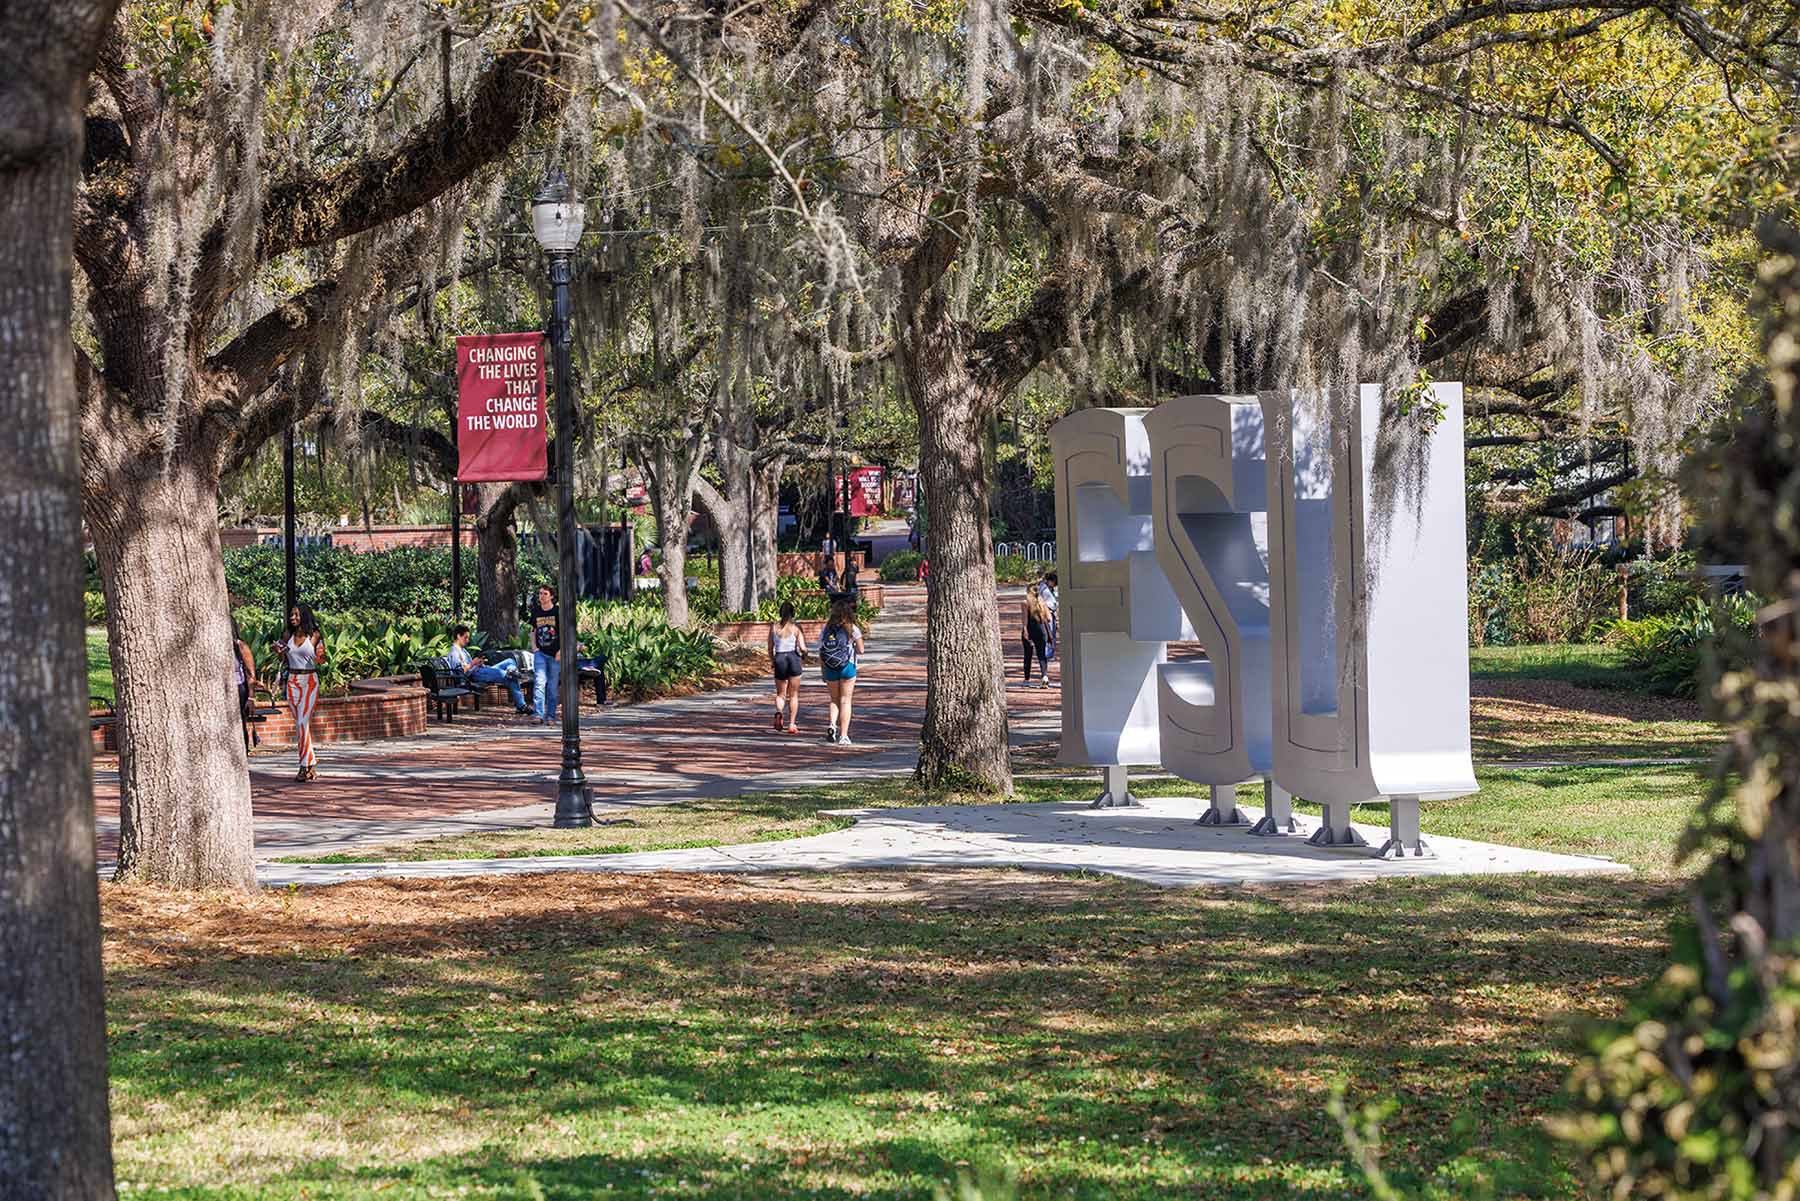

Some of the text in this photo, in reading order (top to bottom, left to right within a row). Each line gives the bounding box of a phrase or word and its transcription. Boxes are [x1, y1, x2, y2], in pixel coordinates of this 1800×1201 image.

[469, 346, 536, 362] CHANGING
[478, 363, 536, 379] THE LIVES
[505, 380, 537, 394] THAT
[486, 397, 537, 412] CHANGE
[467, 414, 537, 430] THE WORLD
[1049, 383, 1384, 802] FSU
